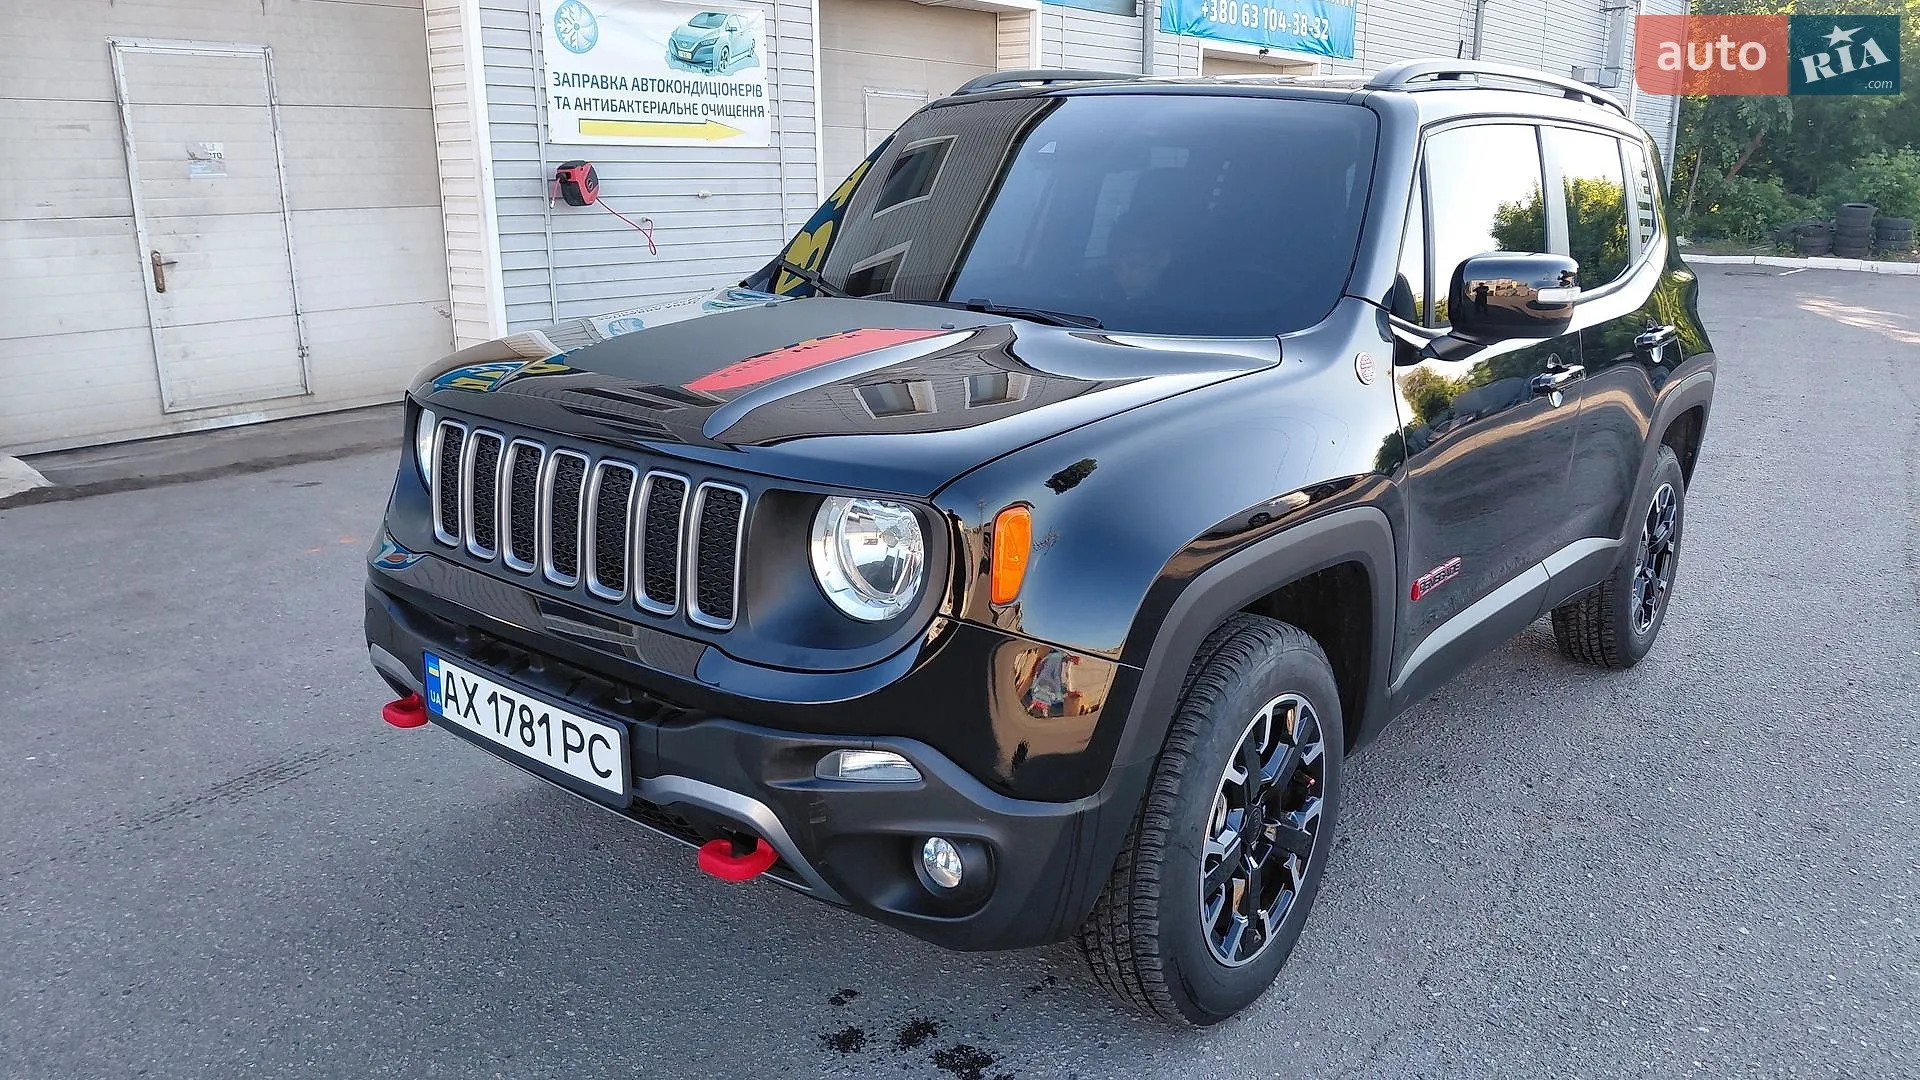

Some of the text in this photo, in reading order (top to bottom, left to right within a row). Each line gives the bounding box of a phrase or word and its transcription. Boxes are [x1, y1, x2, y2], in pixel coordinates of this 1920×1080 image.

[1200, 0, 1329, 41] +380 63 104-38-32
[552, 71, 763, 98] ЗАПРАВКА АВТОКОНДИЦІОНЕРІВ
[554, 95, 765, 118] ТА АНТИБАКТЕРІАЛЬНЕ ОЧИЩЕННЯ
[430, 689, 442, 706] UA
[444, 670, 613, 779] AX 1781 PC
